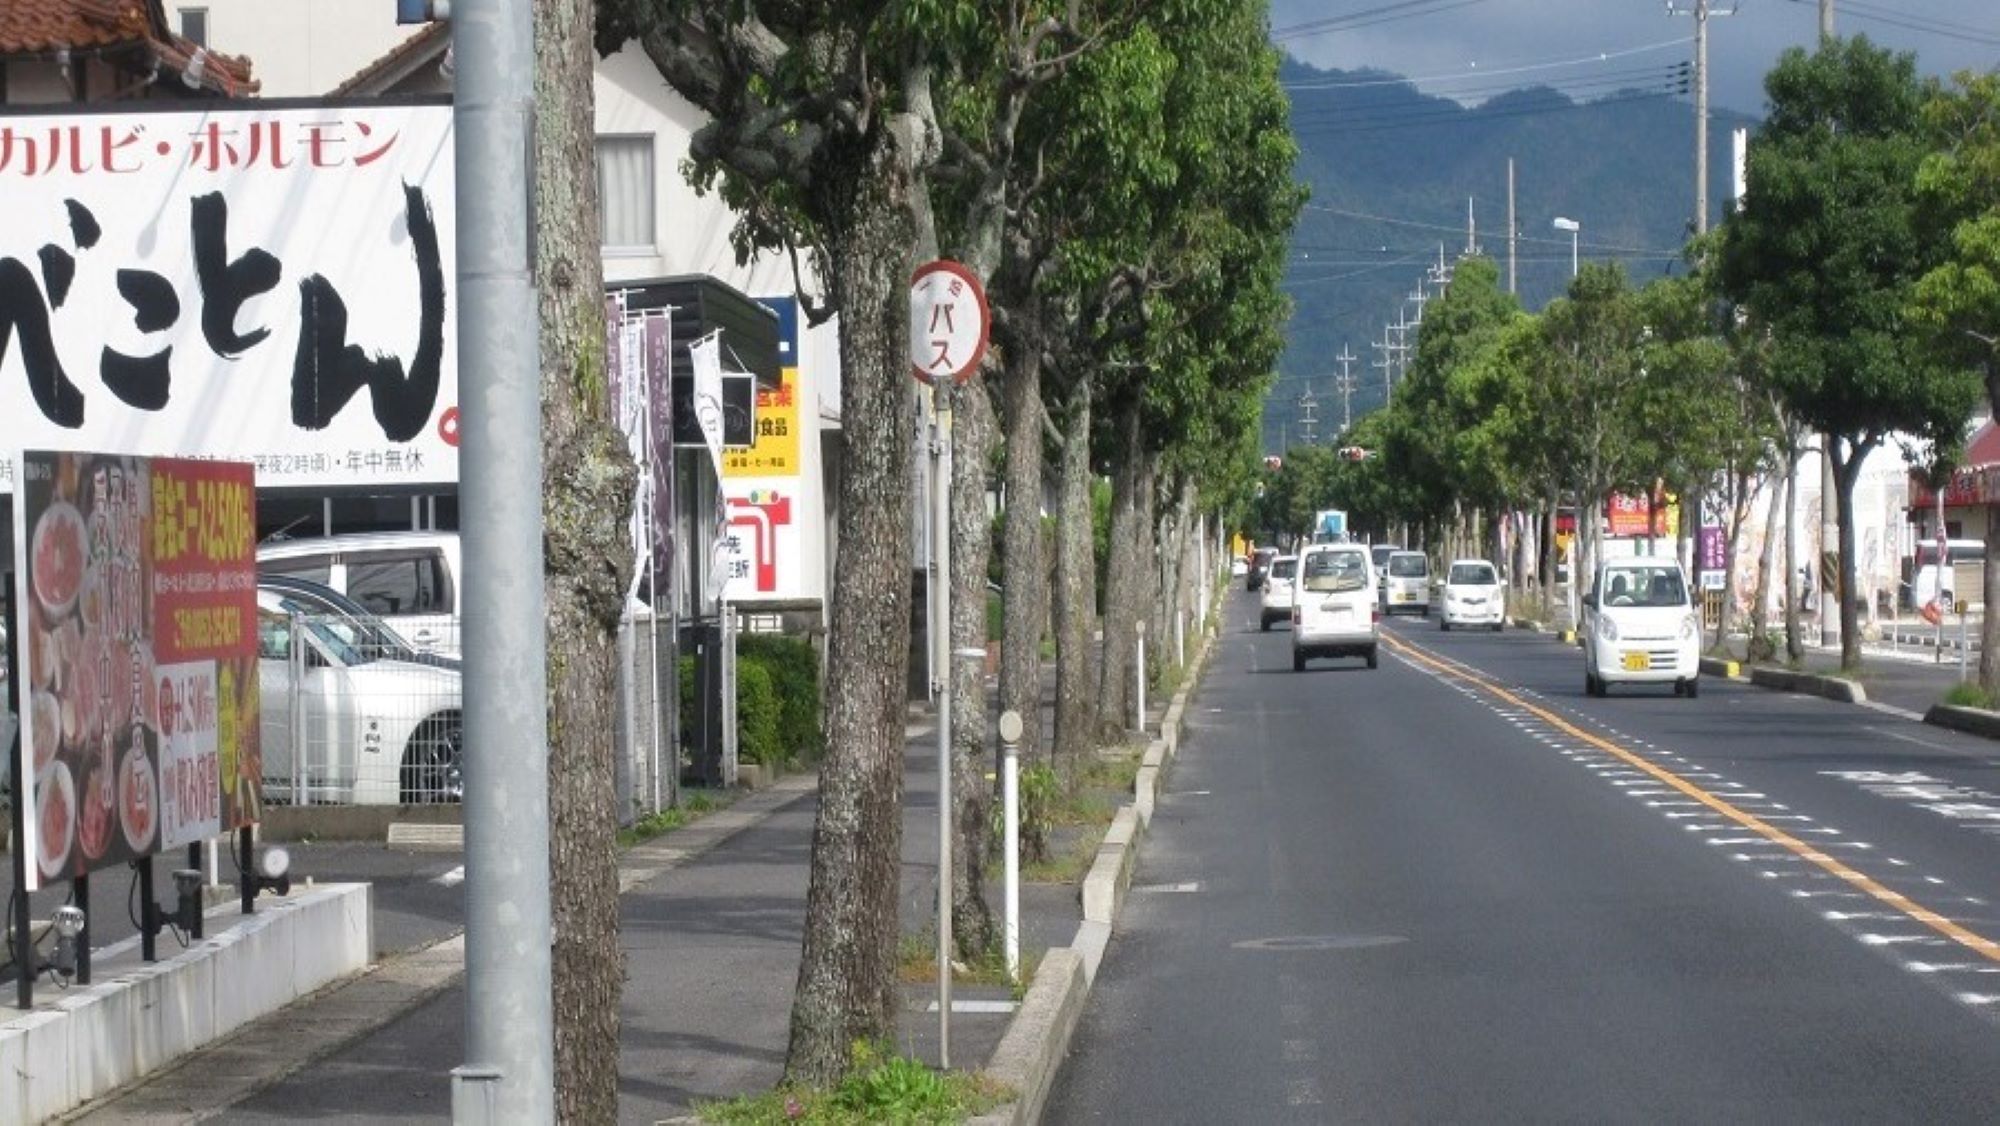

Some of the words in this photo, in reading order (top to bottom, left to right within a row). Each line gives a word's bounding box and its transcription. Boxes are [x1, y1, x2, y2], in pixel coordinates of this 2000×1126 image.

[0, 120, 399, 176] カルビ・ホルモン
[929, 303, 955, 370] バス
